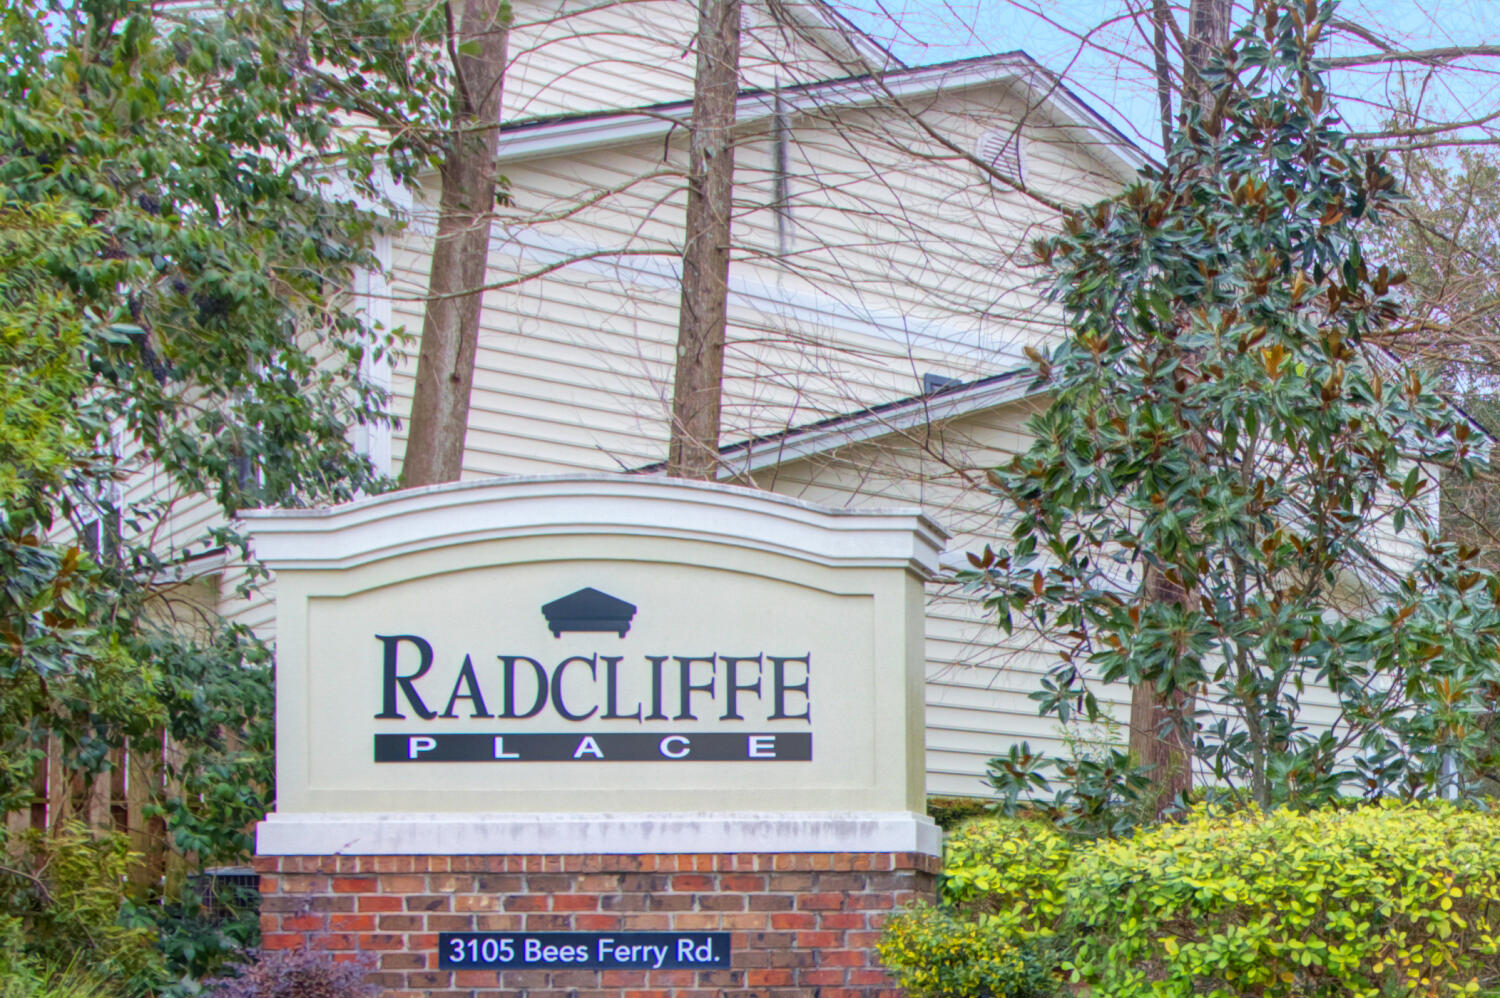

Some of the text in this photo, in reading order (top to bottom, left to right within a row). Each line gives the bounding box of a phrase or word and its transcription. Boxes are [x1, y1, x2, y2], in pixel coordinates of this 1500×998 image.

[374, 634, 812, 724] RADCLIFFE
[408, 735, 777, 759] PLACE
[449, 937, 720, 968] 3105 Bees Ferry Rd.
